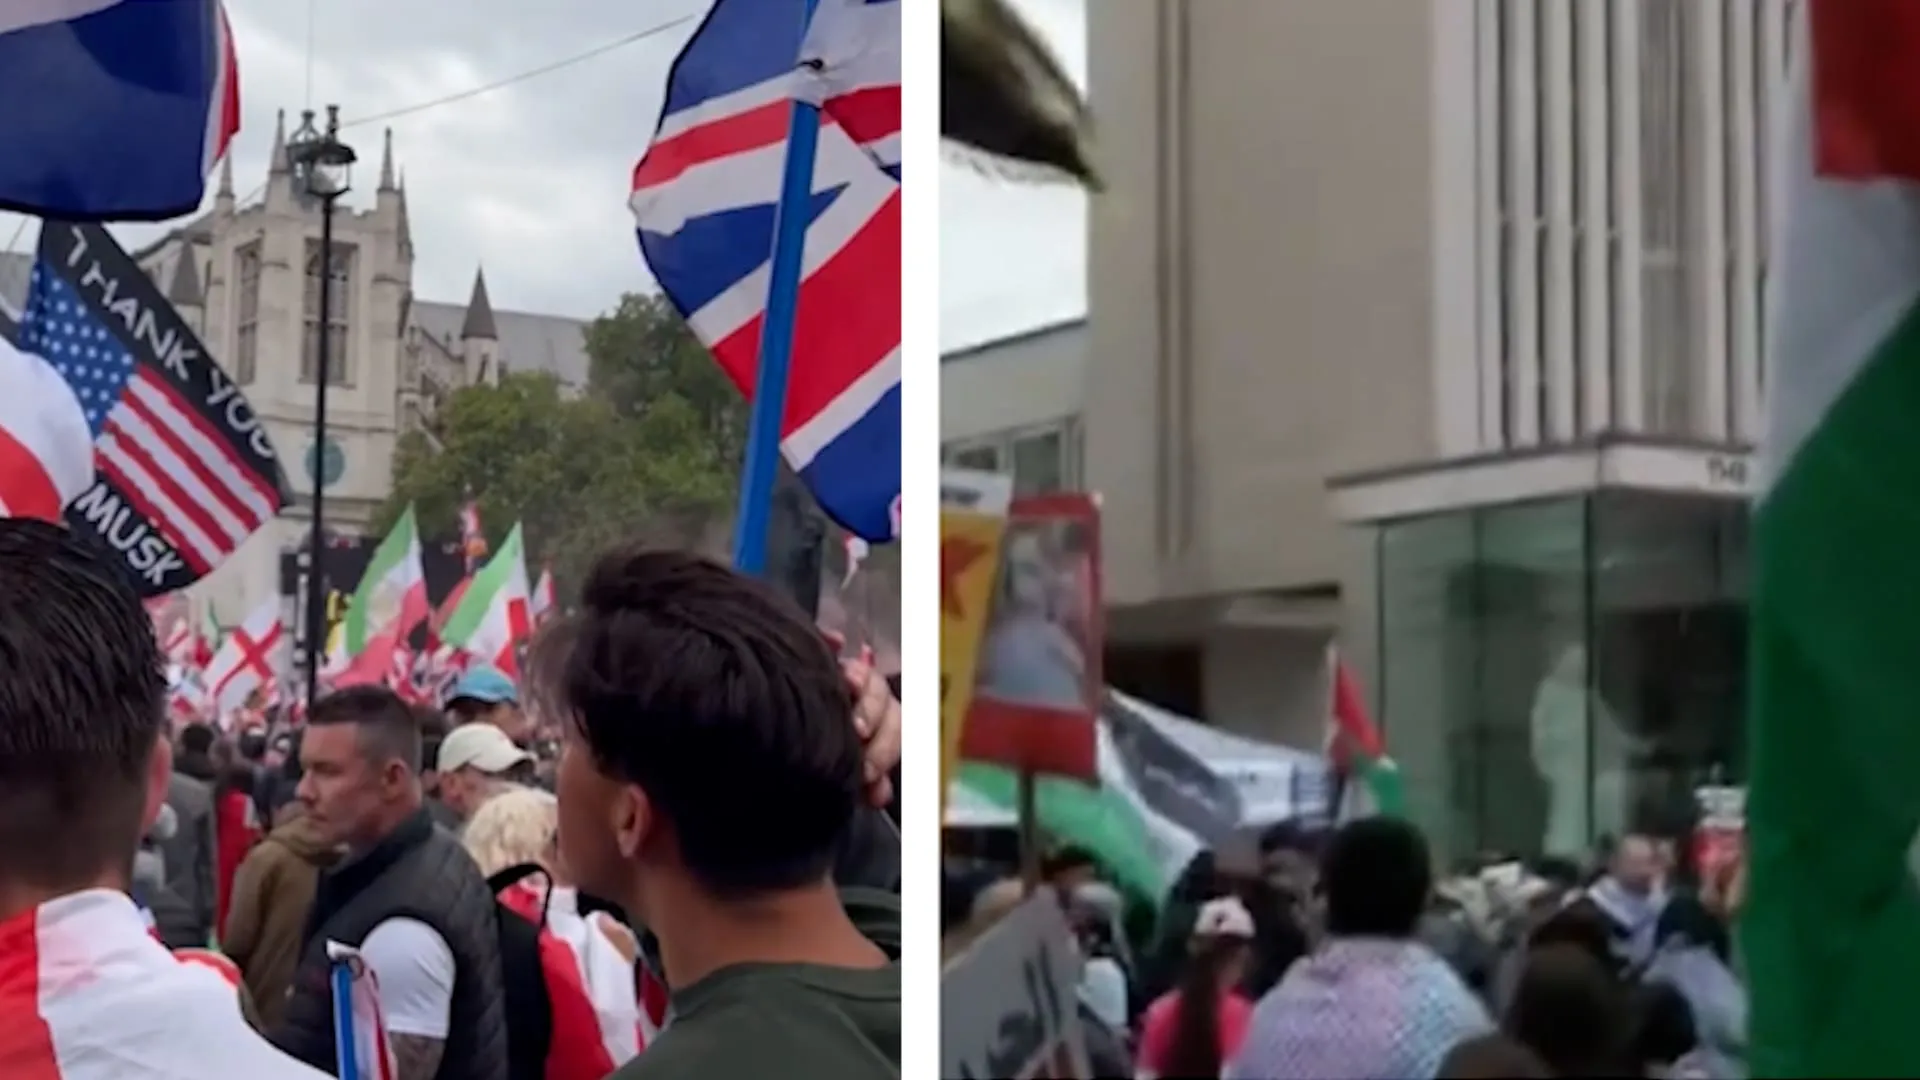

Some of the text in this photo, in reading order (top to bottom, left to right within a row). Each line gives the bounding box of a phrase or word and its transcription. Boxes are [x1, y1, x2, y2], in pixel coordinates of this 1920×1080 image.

[66, 226, 275, 458] THANK YOU
[76, 483, 183, 586] MUSK
